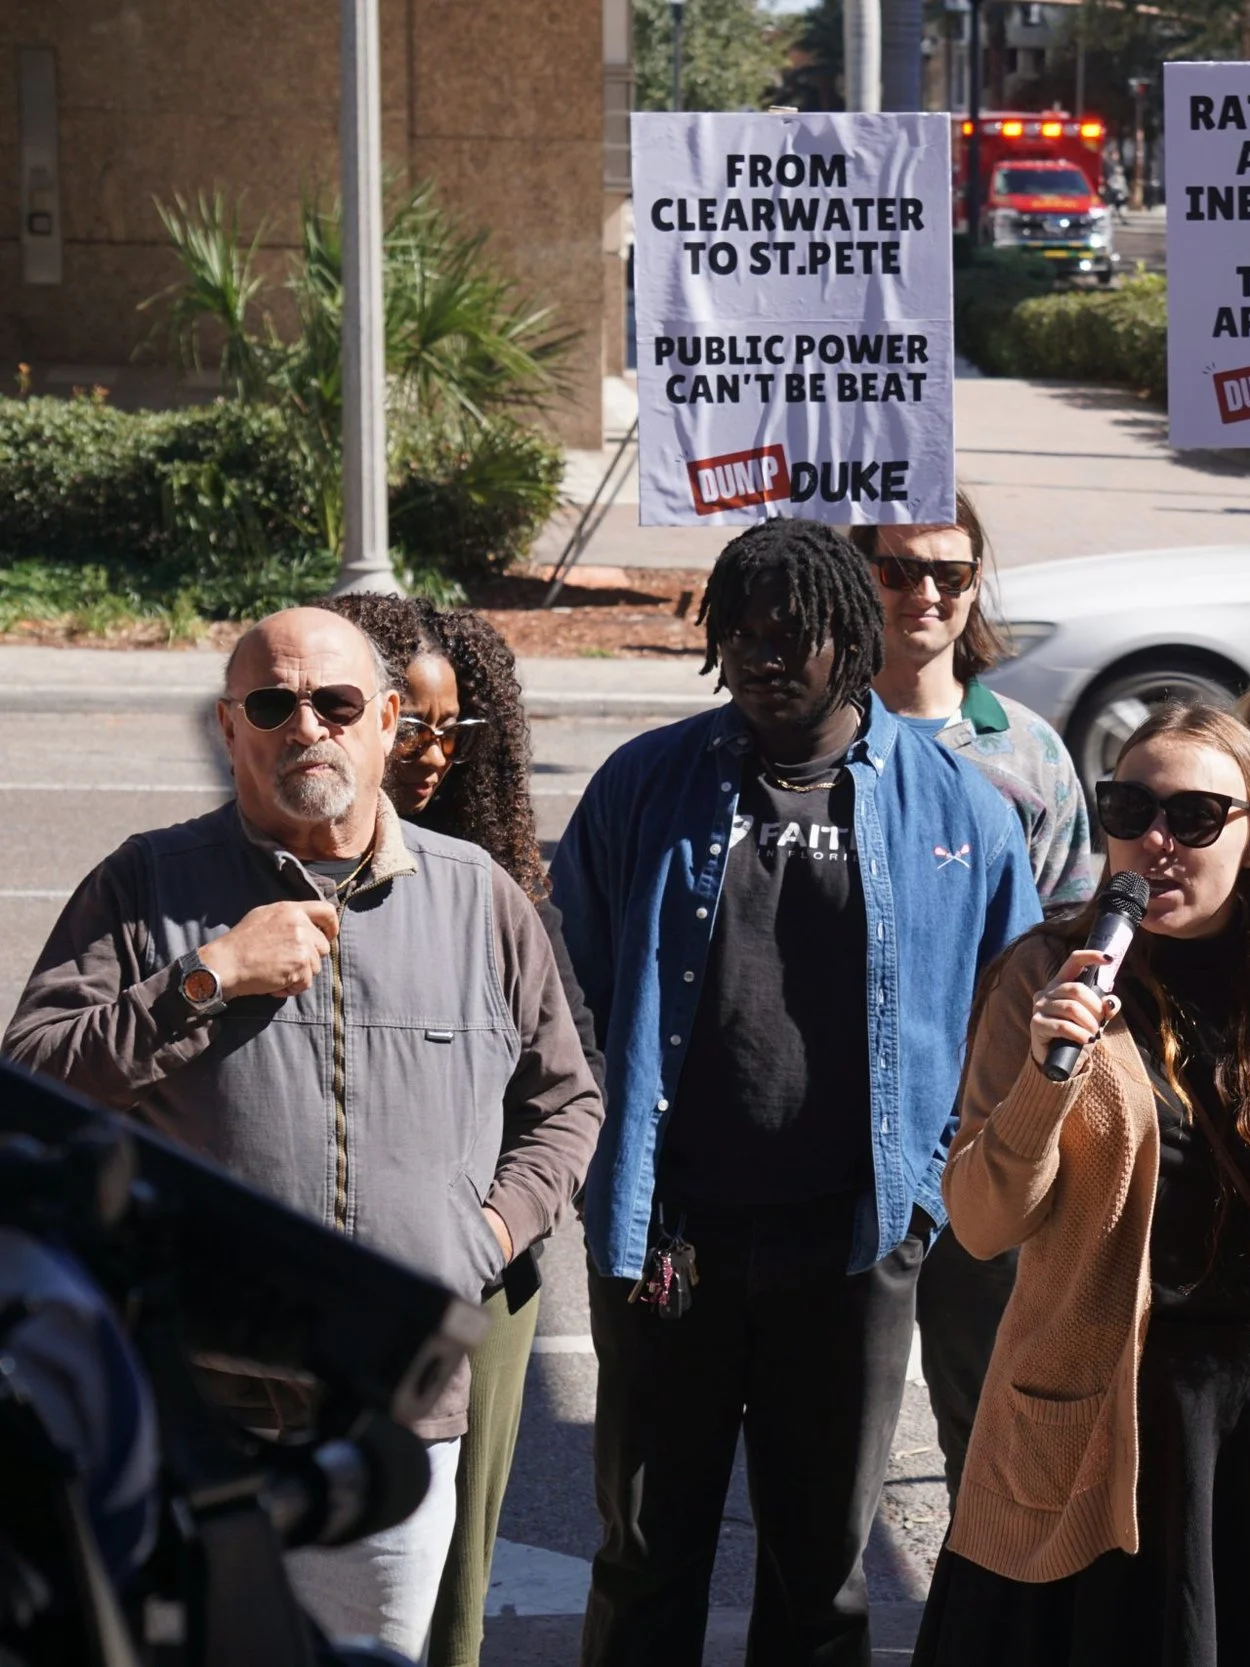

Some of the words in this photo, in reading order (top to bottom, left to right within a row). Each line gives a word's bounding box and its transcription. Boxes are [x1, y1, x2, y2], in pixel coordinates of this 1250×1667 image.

[727, 153, 847, 188] FROM
[651, 197, 925, 232] CLEARWATER
[683, 241, 738, 275] TO
[749, 240, 901, 275] ST.PETE
[654, 335, 785, 367] PUBLIC
[795, 335, 929, 366] POWER
[666, 371, 774, 405] CAN'T
[785, 372, 827, 403] BE
[837, 371, 927, 404] BEAT
[697, 455, 779, 504] DUMP
[790, 460, 909, 504] DUKE
